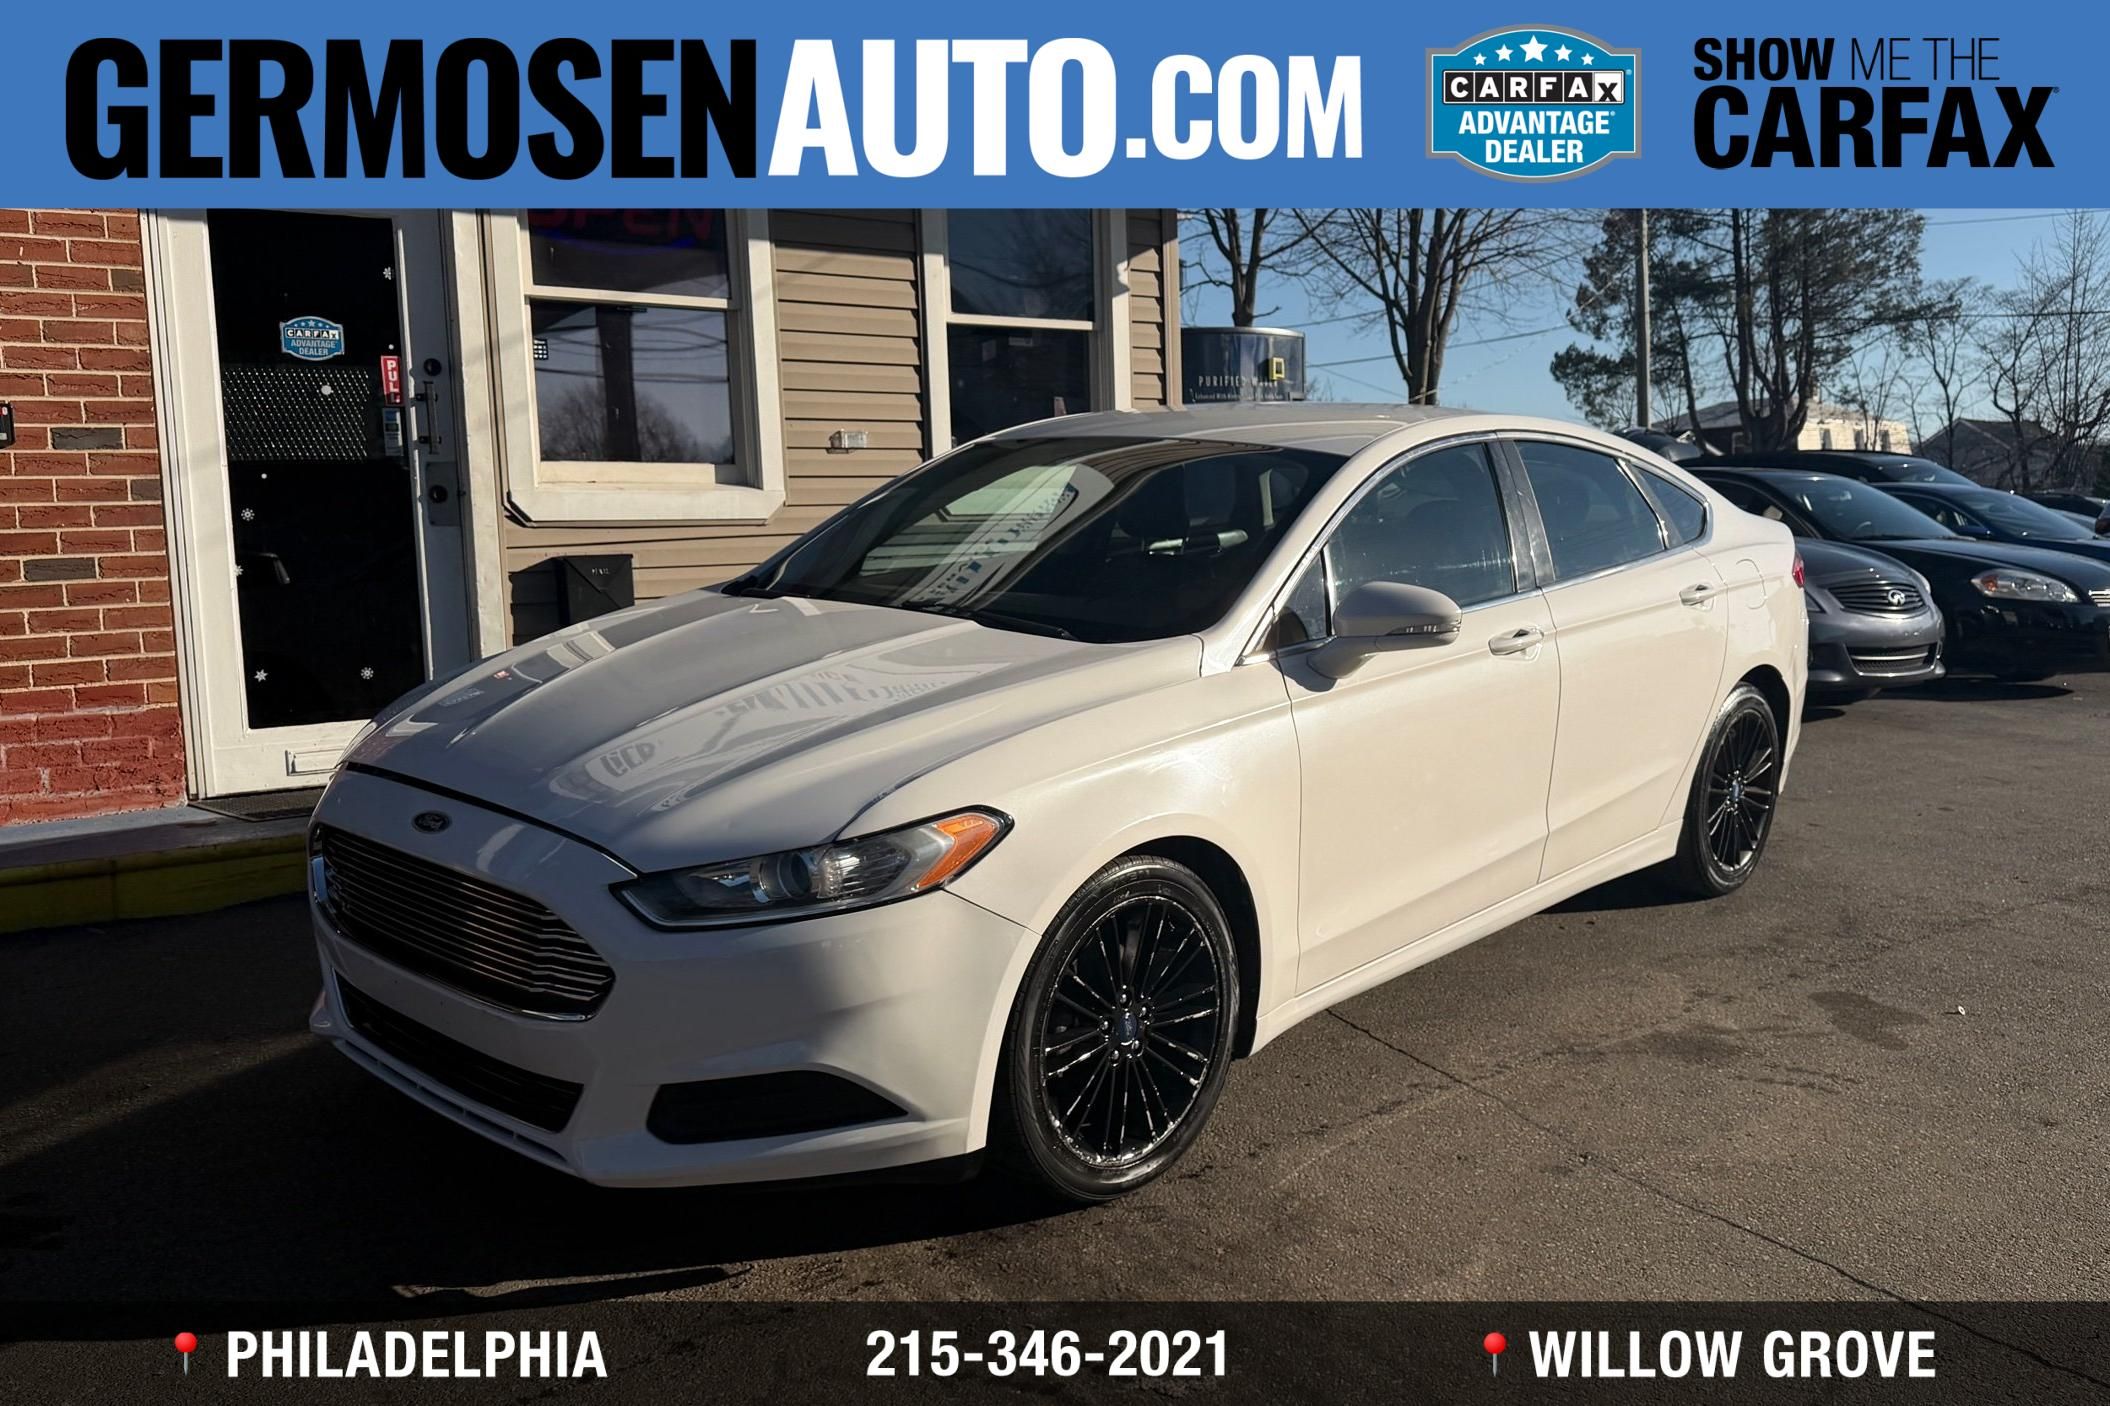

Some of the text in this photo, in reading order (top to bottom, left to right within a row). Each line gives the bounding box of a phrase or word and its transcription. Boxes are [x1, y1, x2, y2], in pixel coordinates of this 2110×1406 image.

[287, 329, 338, 339] CARFAX
[290, 339, 337, 348] ADVANTAGE
[299, 347, 329, 355] DEALER
